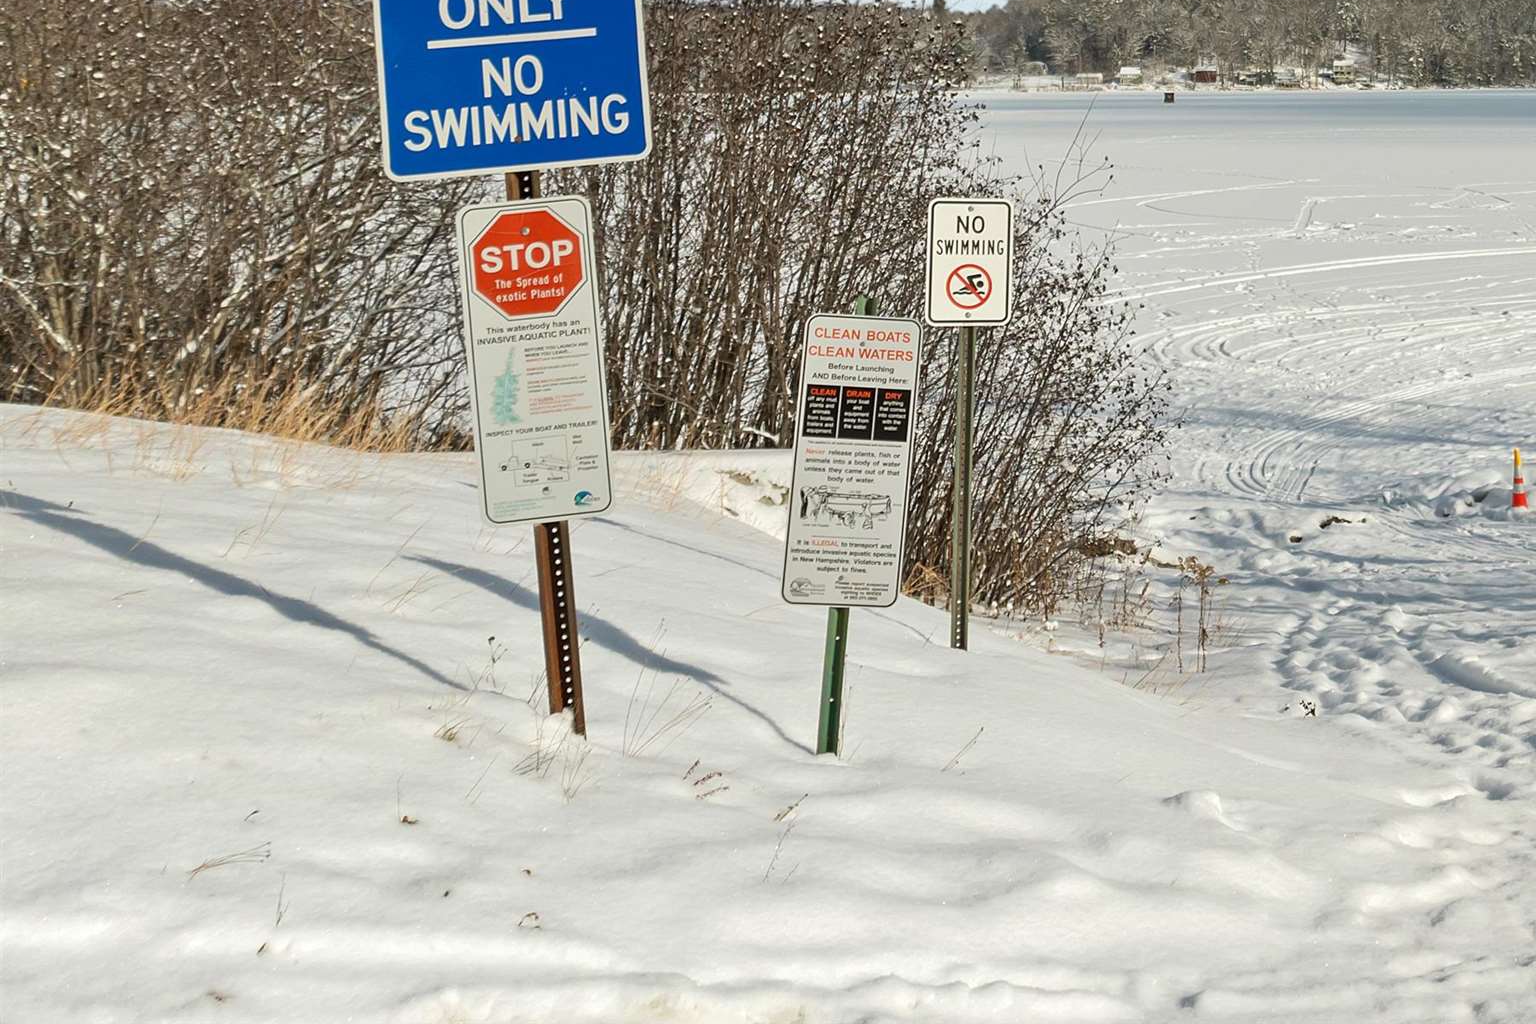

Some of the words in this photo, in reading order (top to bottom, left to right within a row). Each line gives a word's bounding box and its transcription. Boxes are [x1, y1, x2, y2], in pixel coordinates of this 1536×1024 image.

[482, 55, 543, 98] NO
[403, 93, 629, 151] SWIMMING
[956, 216, 985, 234] NO
[936, 239, 1004, 256] SWIMMING
[481, 240, 574, 274] STOP
[495, 279, 512, 290] The
[516, 275, 550, 289] Spread
[553, 273, 563, 283] of
[496, 290, 527, 304] exotic
[530, 287, 565, 300] Plants!
[506, 322, 550, 332] waterbody
[552, 320, 568, 328] has
[477, 335, 518, 346] INVASIVE
[518, 330, 558, 342] AQUATIC
[560, 328, 591, 336] PLANT!
[814, 328, 860, 340] CLEAN
[866, 330, 911, 343] BOATS
[808, 345, 854, 358] CLEAN
[860, 348, 914, 362] WATERS
[856, 364, 895, 374] Launching
[831, 374, 856, 382] Before
[858, 375, 887, 384] Leaving
[811, 388, 837, 396] CLEAN
[847, 390, 871, 398] DRAIN
[885, 392, 902, 400] DRY
[486, 430, 514, 438] INSPECT
